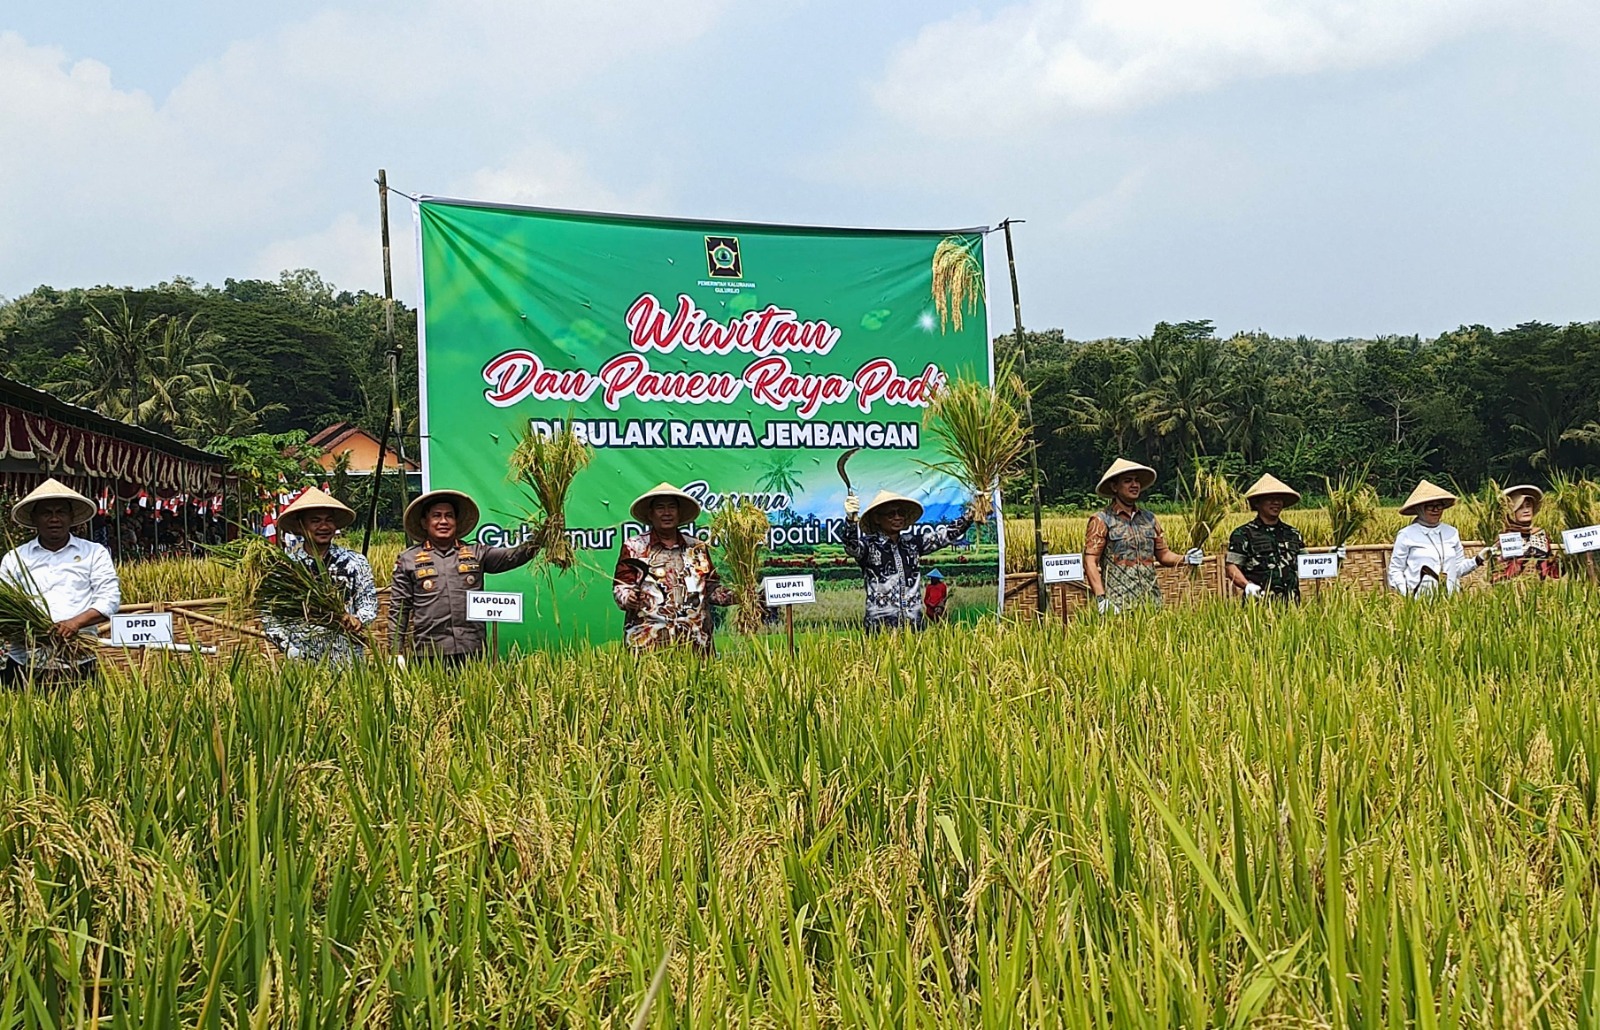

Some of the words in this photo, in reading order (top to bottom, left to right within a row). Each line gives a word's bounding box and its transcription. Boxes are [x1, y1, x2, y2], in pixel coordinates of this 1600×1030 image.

[626, 294, 842, 357] Wiwitan
[483, 351, 599, 408] Dan
[600, 353, 744, 412] Panen
[744, 355, 854, 420] Raya
[571, 421, 665, 447] BULAK
[670, 422, 756, 447] RAWA
[760, 422, 918, 448] JEMBANGAN
[1573, 530, 1598, 539] KAJATI
[1582, 540, 1594, 548] DIY
[1045, 558, 1081, 567] GUBERNUR
[1058, 569, 1070, 577] DIY
[1312, 568, 1325, 576] DIY
[775, 580, 804, 590] BUPATI
[769, 591, 790, 600] KULON
[791, 590, 812, 599] PROGO
[472, 596, 517, 606] KAPOLDA
[486, 609, 503, 618] DIY
[126, 619, 156, 628] DPRD
[132, 633, 151, 641] DIY
